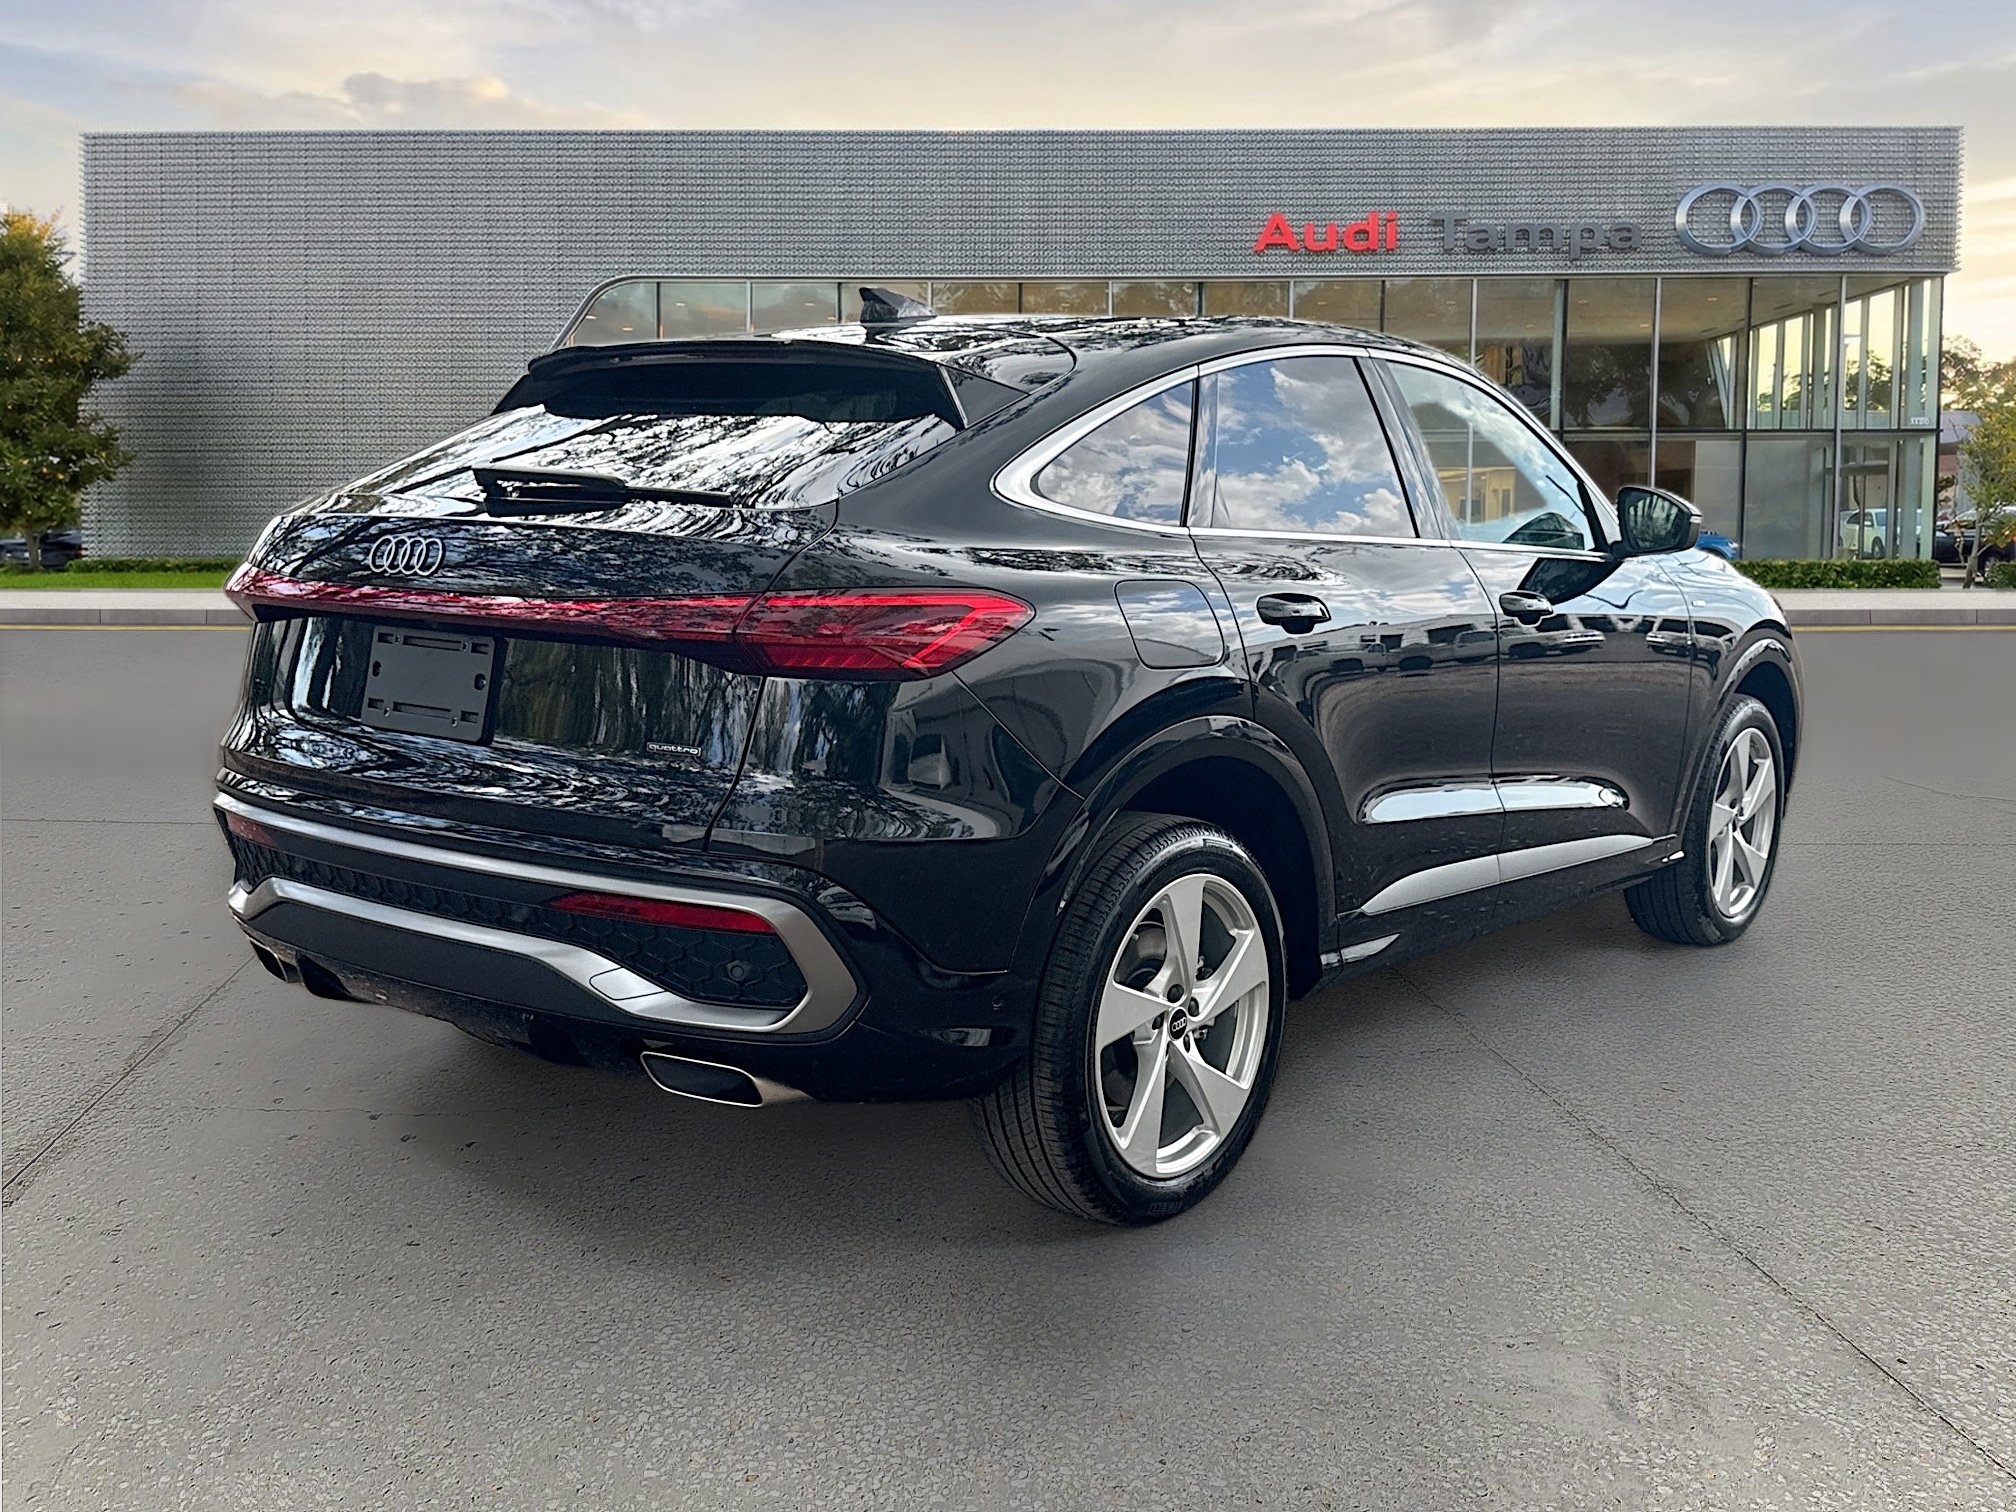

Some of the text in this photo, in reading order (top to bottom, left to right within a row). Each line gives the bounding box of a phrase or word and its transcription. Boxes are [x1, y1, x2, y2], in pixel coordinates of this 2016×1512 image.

[1253, 210, 1642, 261] Audi Tampa
[648, 743, 699, 755] quattro
